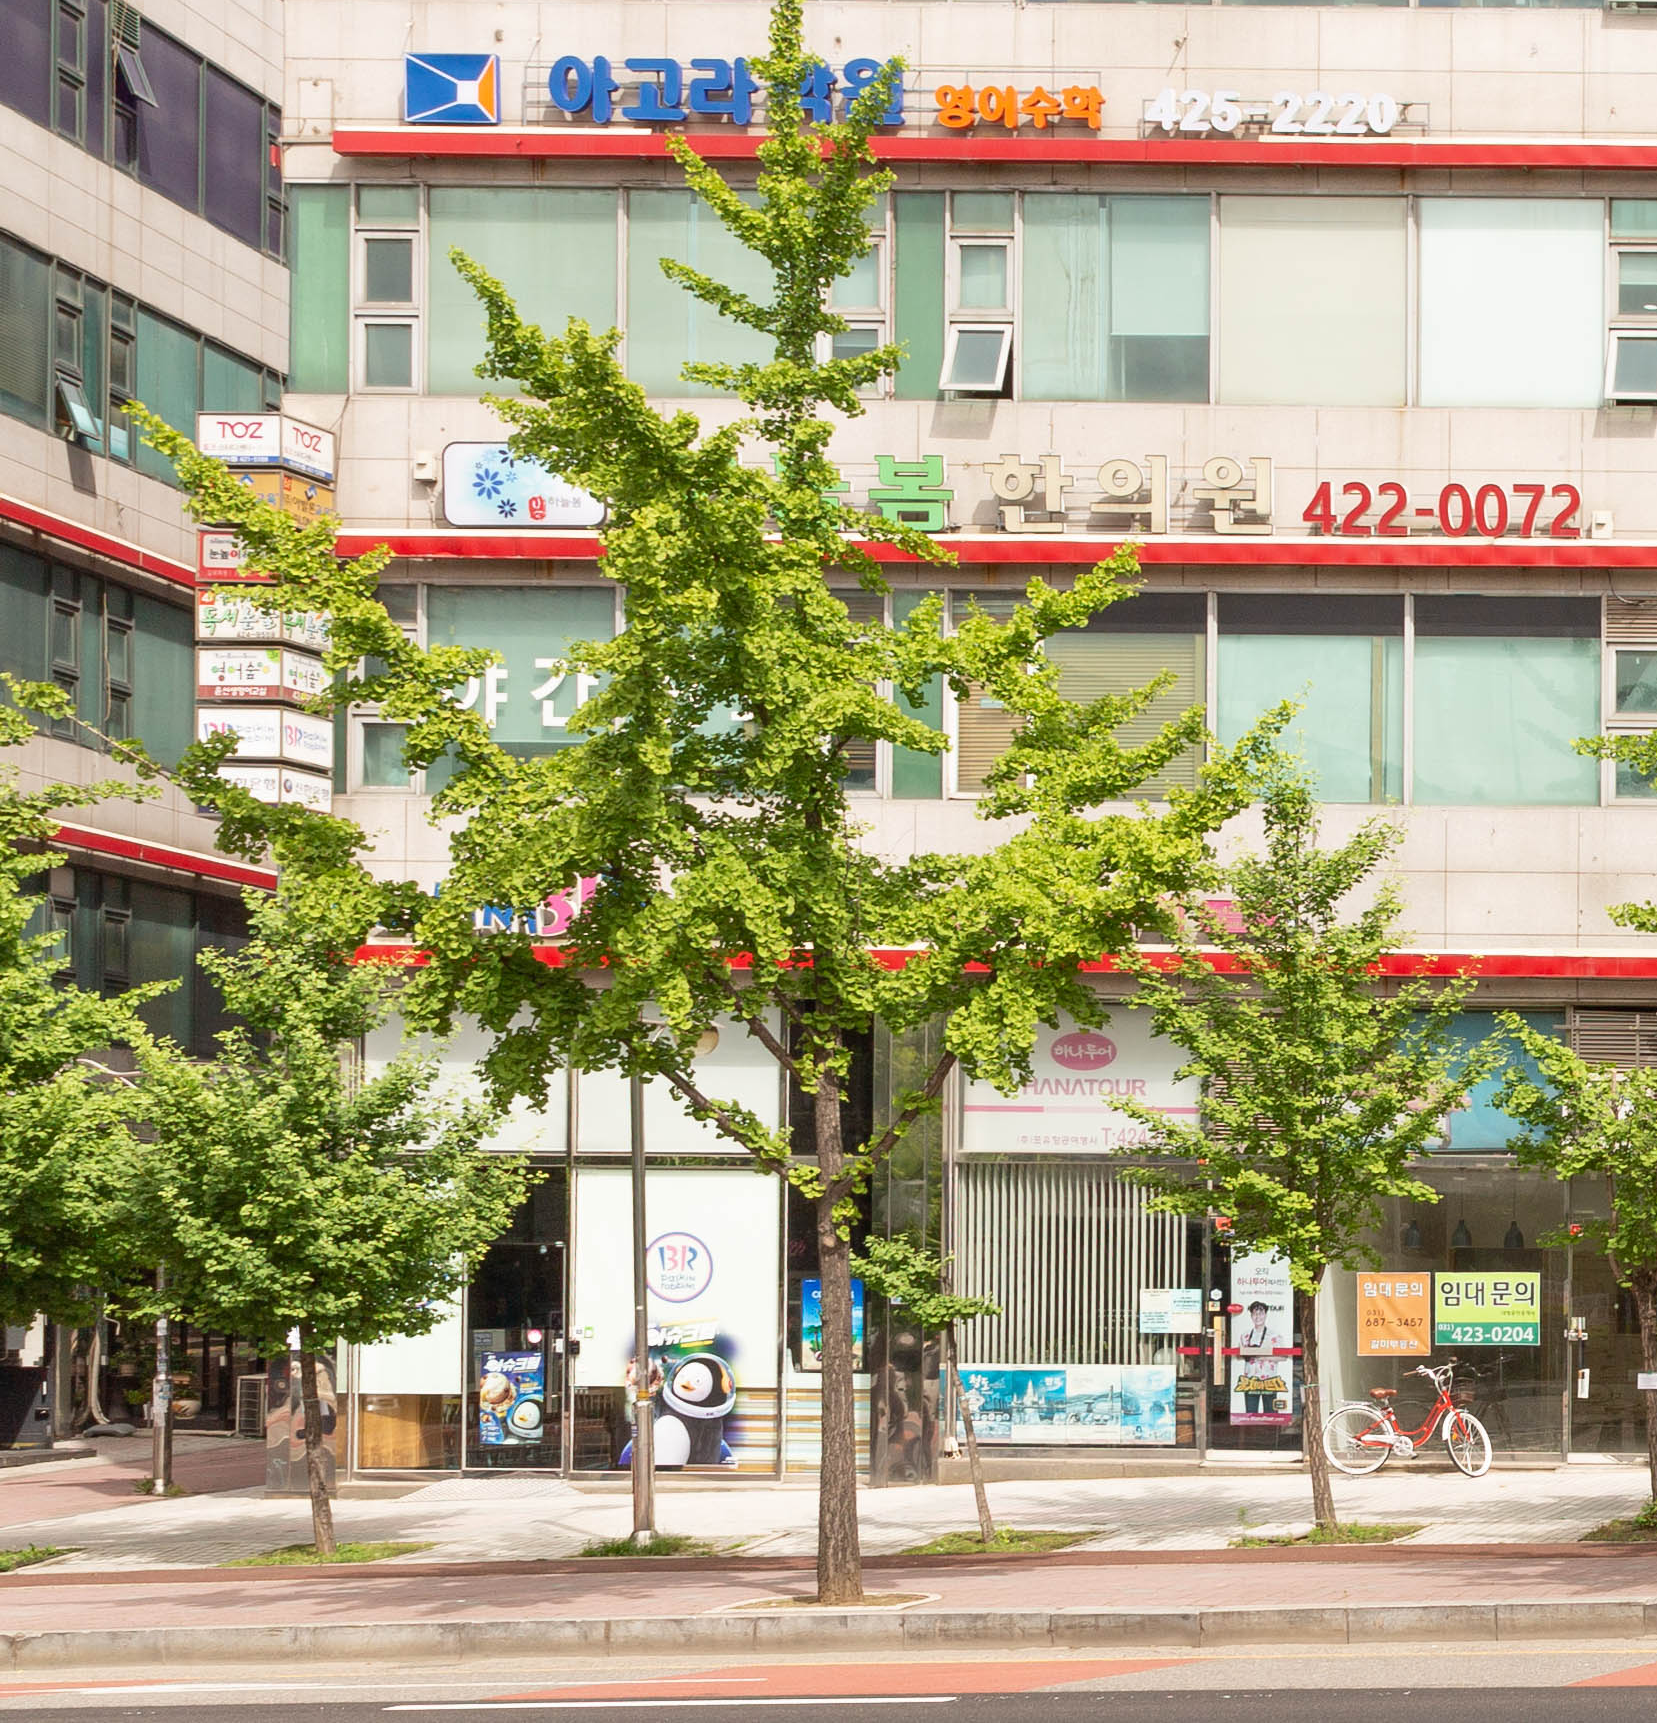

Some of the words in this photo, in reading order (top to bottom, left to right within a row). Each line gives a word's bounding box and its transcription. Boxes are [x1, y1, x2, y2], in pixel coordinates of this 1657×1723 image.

[1145, 87, 1398, 134] 425-2220
[216, 421, 263, 439] TOZ
[292, 426, 322, 453] TOZ
[1302, 481, 1582, 539] 422-0072
[1053, 1043, 1113, 1061] 하나투어
[1022, 1077, 1147, 1097] HANATOUR
[658, 1244, 698, 1271] BR
[1451, 1326, 1535, 1342] 423-0204
